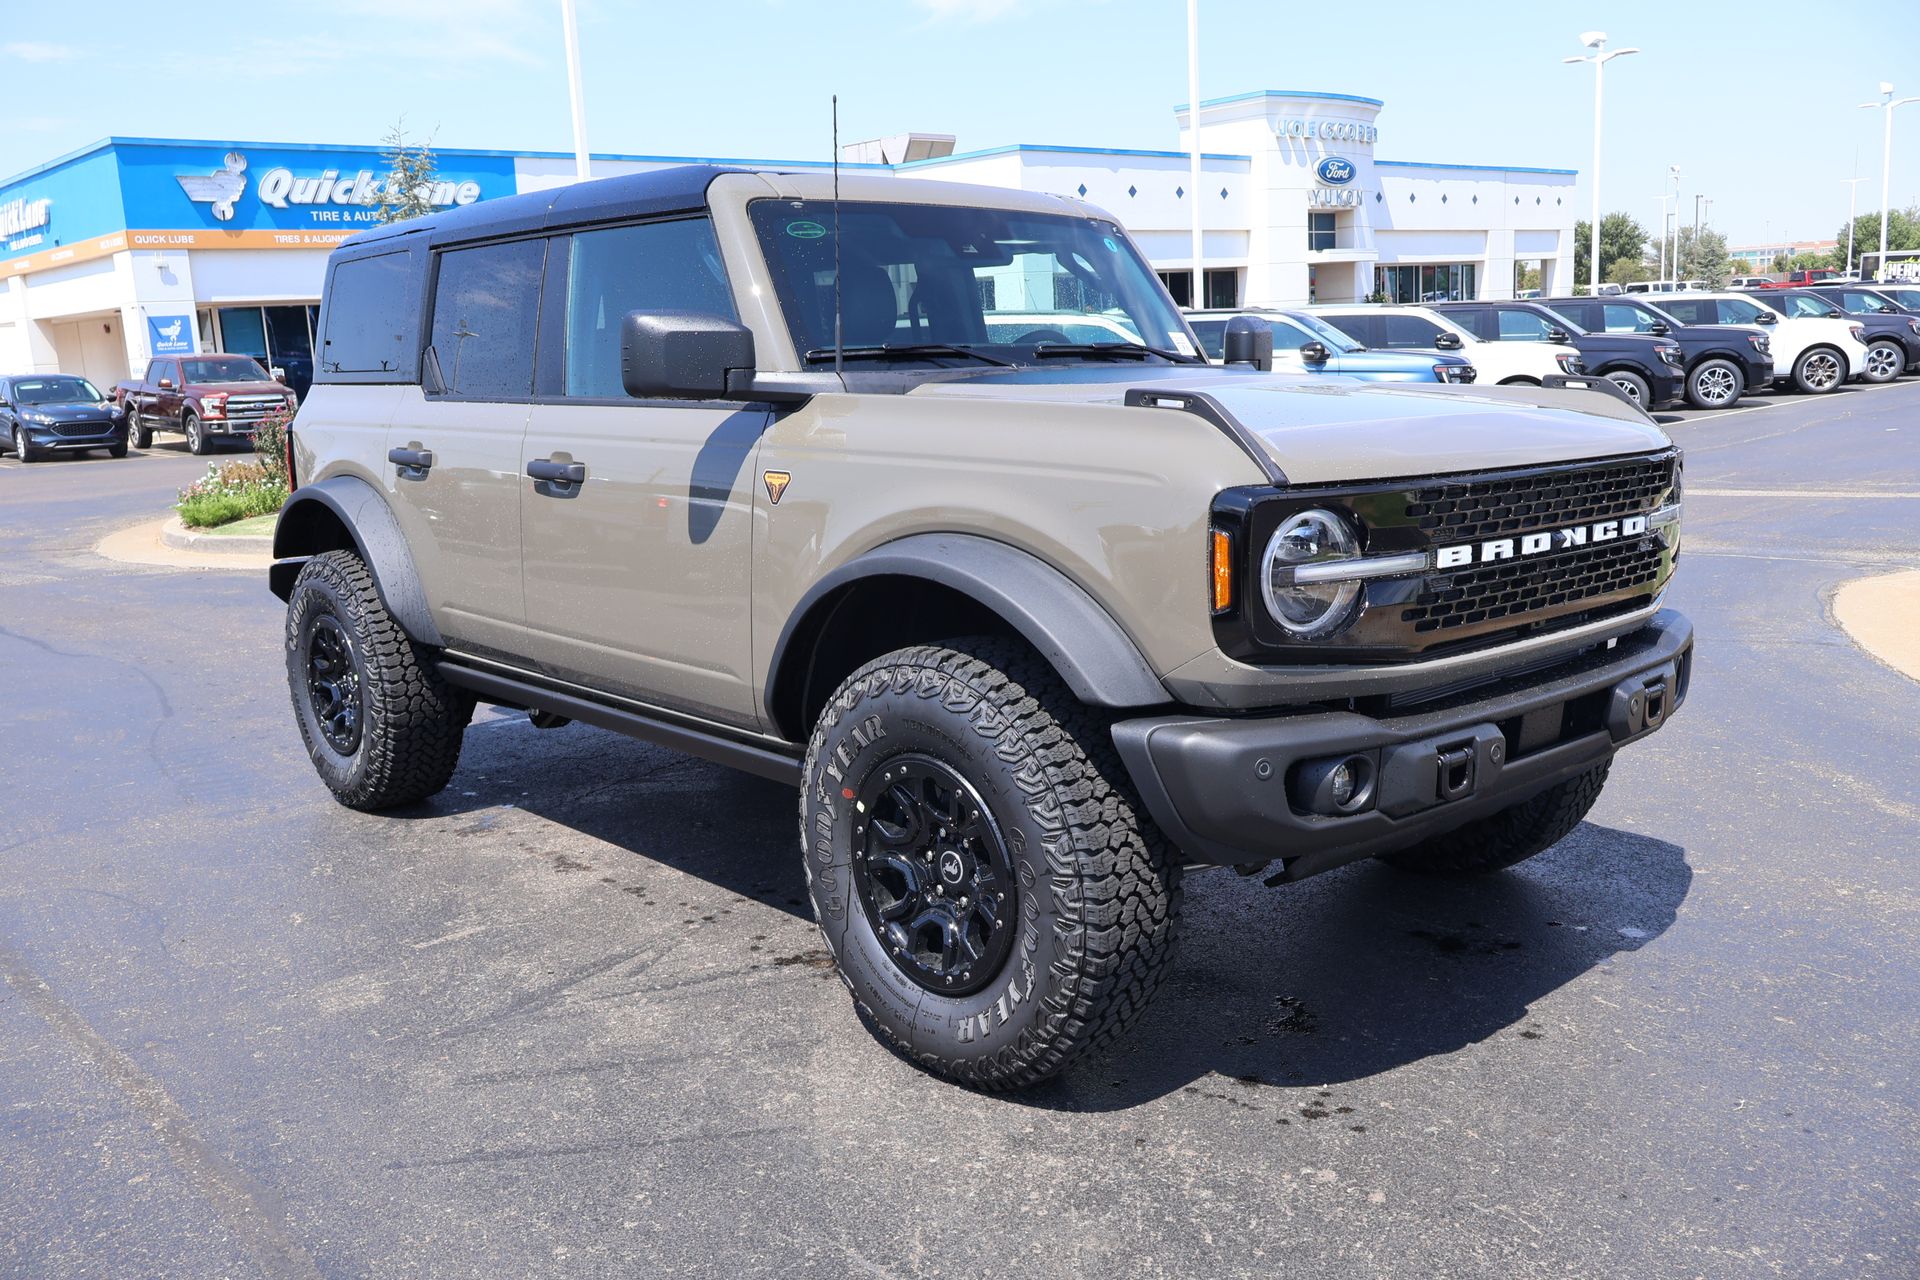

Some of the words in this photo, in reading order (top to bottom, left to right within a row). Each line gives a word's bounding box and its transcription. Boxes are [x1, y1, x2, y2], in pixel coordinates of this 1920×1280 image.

[1279, 120, 1316, 138] JOE
[1321, 121, 1378, 143] COOPER
[1326, 161, 1351, 179] Ford
[1311, 189, 1363, 206] YUKON
[311, 211, 340, 221] TIRE
[343, 211, 351, 221] &
[354, 211, 387, 222] AUT
[134, 235, 166, 244] QUICK
[168, 235, 195, 244] LUBE
[274, 234, 300, 244] TIRES
[304, 234, 311, 243] &
[1437, 516, 1646, 569] BRONCO
